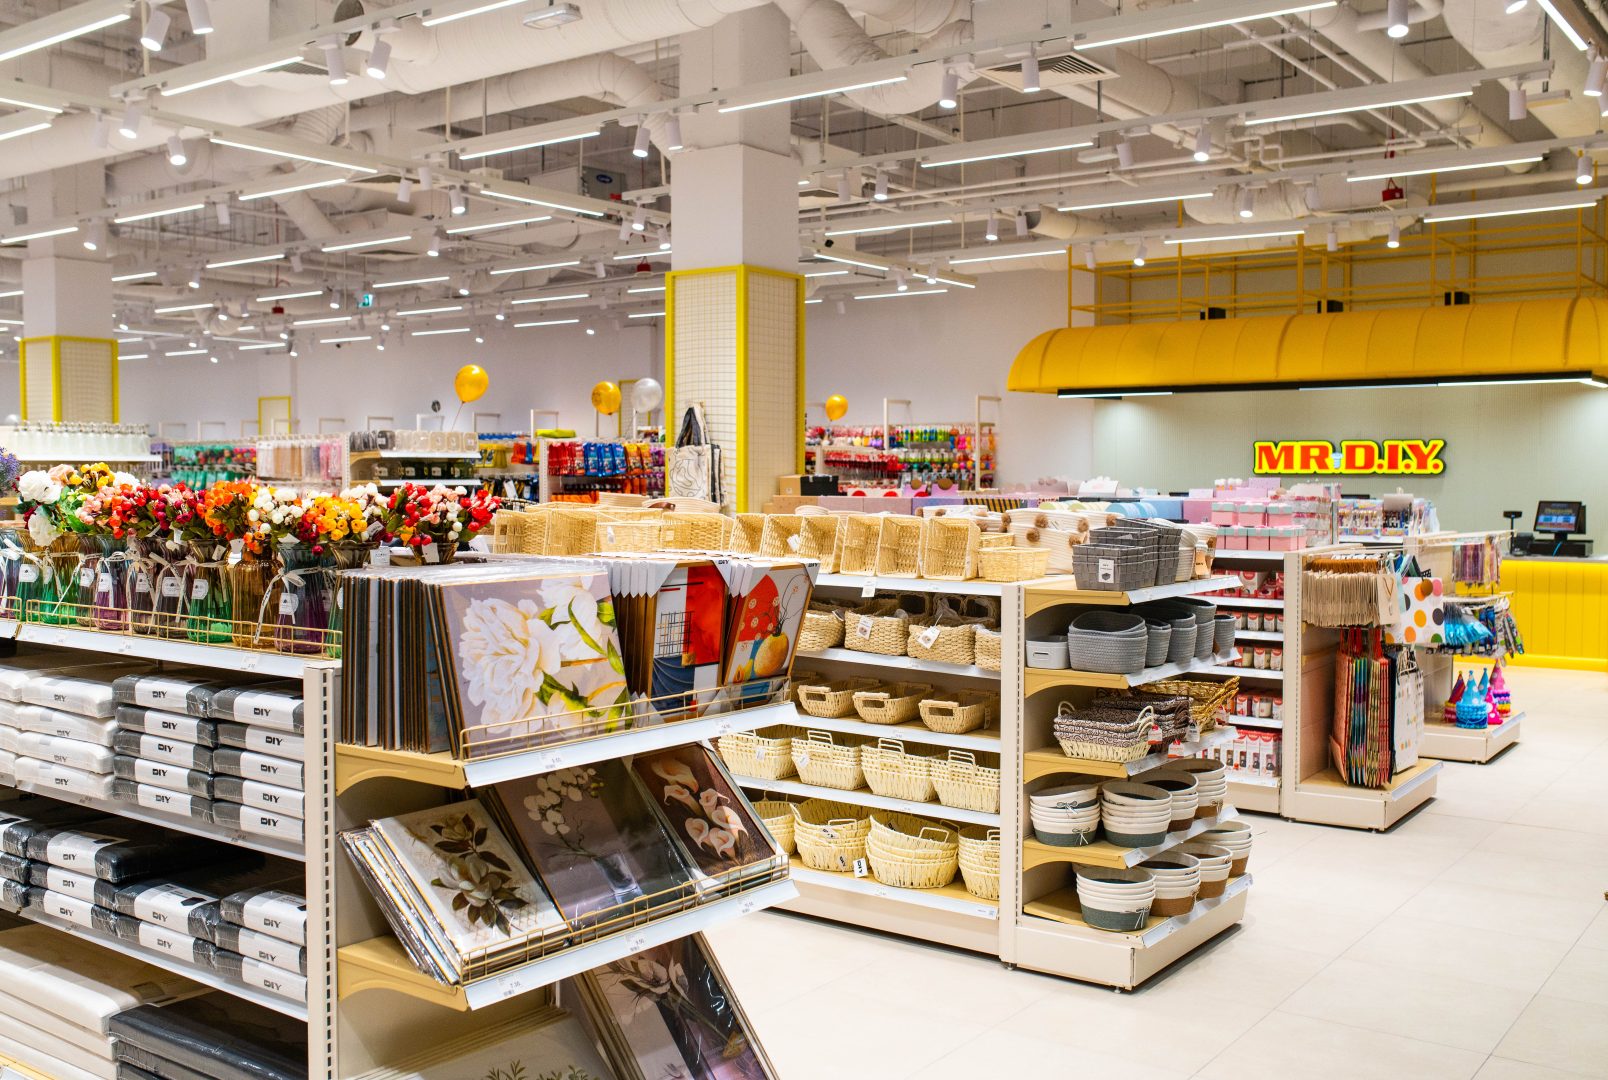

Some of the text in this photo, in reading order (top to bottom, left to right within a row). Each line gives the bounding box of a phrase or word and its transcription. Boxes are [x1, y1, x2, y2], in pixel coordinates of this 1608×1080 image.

[54, 694, 67, 702] DIY
[253, 707, 271, 716] DIY
[162, 721, 178, 730] DIY
[265, 736, 283, 746] DIY
[158, 743, 174, 752] DIY
[152, 768, 168, 776] DIY
[261, 764, 278, 774] DIY
[55, 777, 69, 785] DIY
[155, 795, 171, 803] DIY
[262, 793, 280, 803] DIY
[260, 817, 279, 827] DIY
[62, 880, 76, 888] DIY
[60, 907, 74, 916] DIY
[152, 911, 168, 922] DIY
[263, 918, 281, 929] DIY
[157, 938, 173, 949] DIY
[259, 950, 277, 962] DIY
[263, 979, 282, 991] DIY
